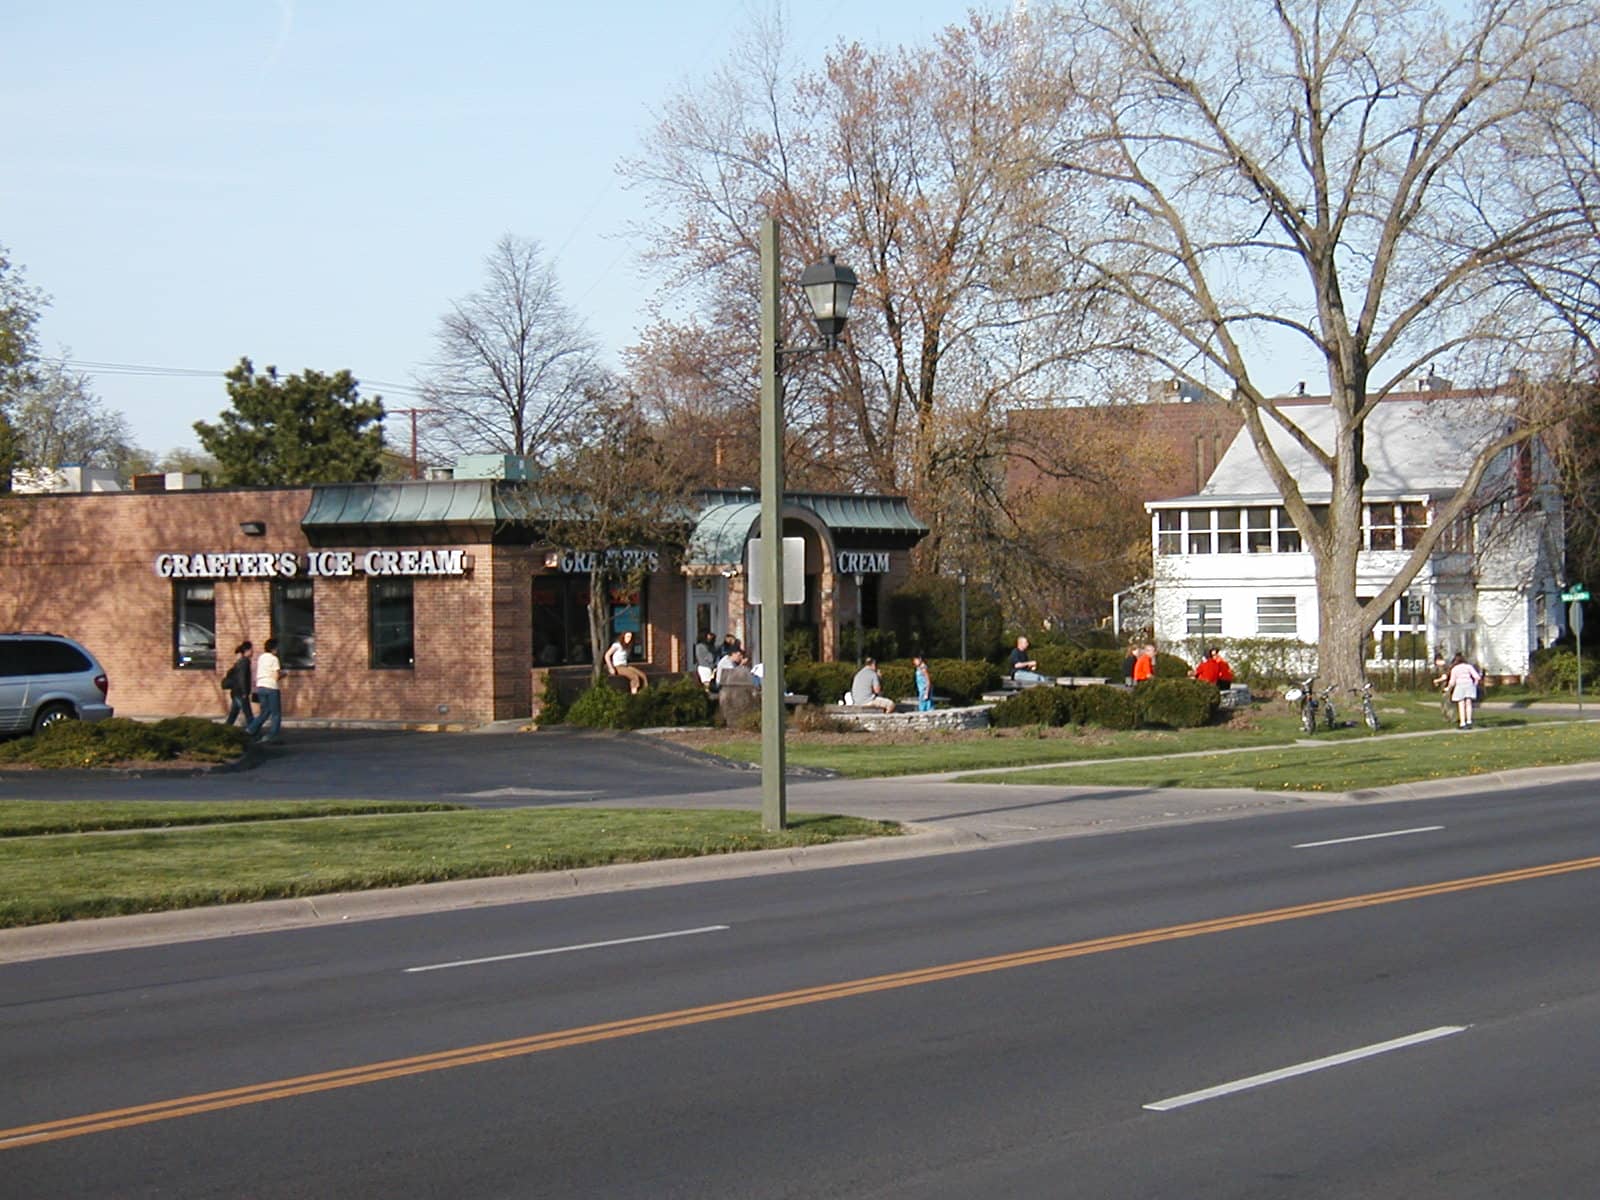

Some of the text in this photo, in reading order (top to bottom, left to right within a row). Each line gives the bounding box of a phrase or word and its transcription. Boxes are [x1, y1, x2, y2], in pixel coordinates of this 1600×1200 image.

[155, 549, 465, 578] GRAETER'S ICE CREAM
[838, 551, 890, 573] CREAM
